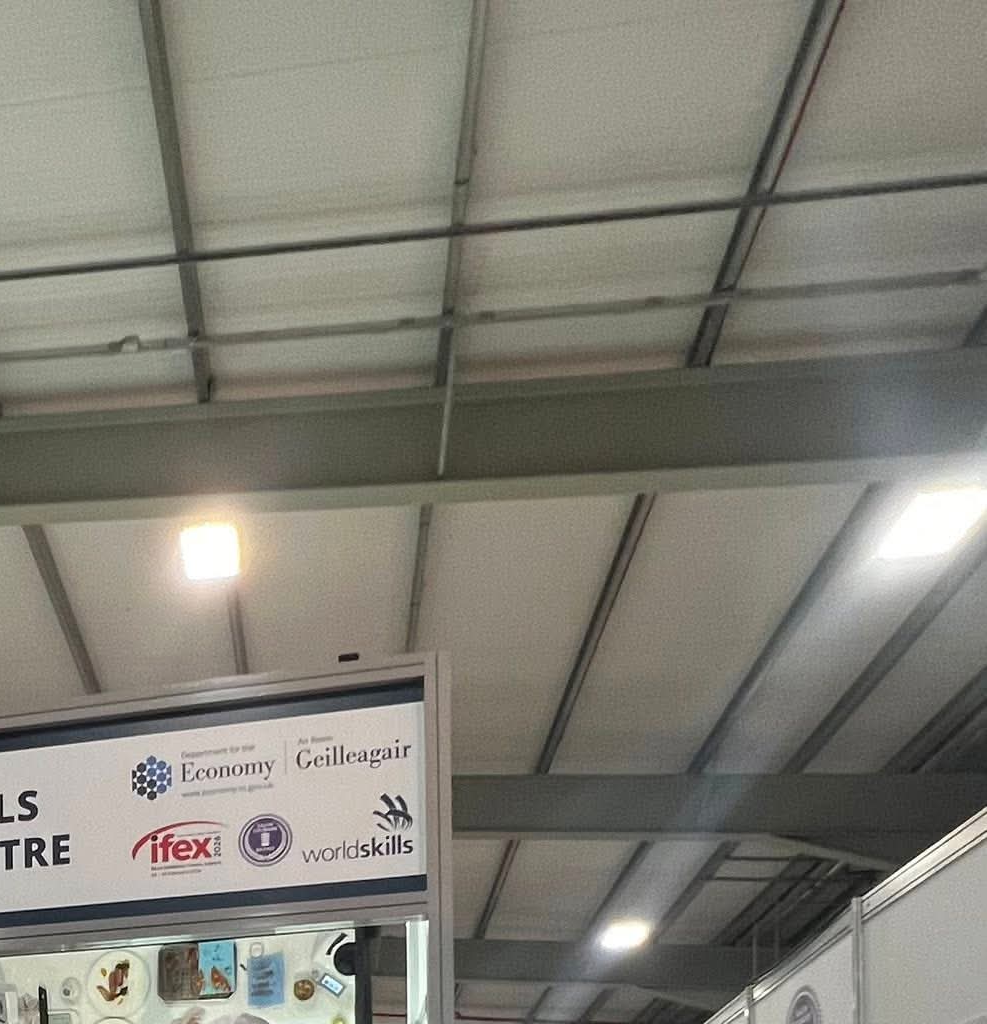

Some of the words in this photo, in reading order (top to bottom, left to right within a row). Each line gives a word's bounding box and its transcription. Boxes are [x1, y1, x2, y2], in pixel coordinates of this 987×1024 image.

[296, 739, 412, 769] Geilleagair
[180, 759, 276, 783] Economy
[150, 833, 212, 864] ifex
[302, 834, 414, 863] worldskills
